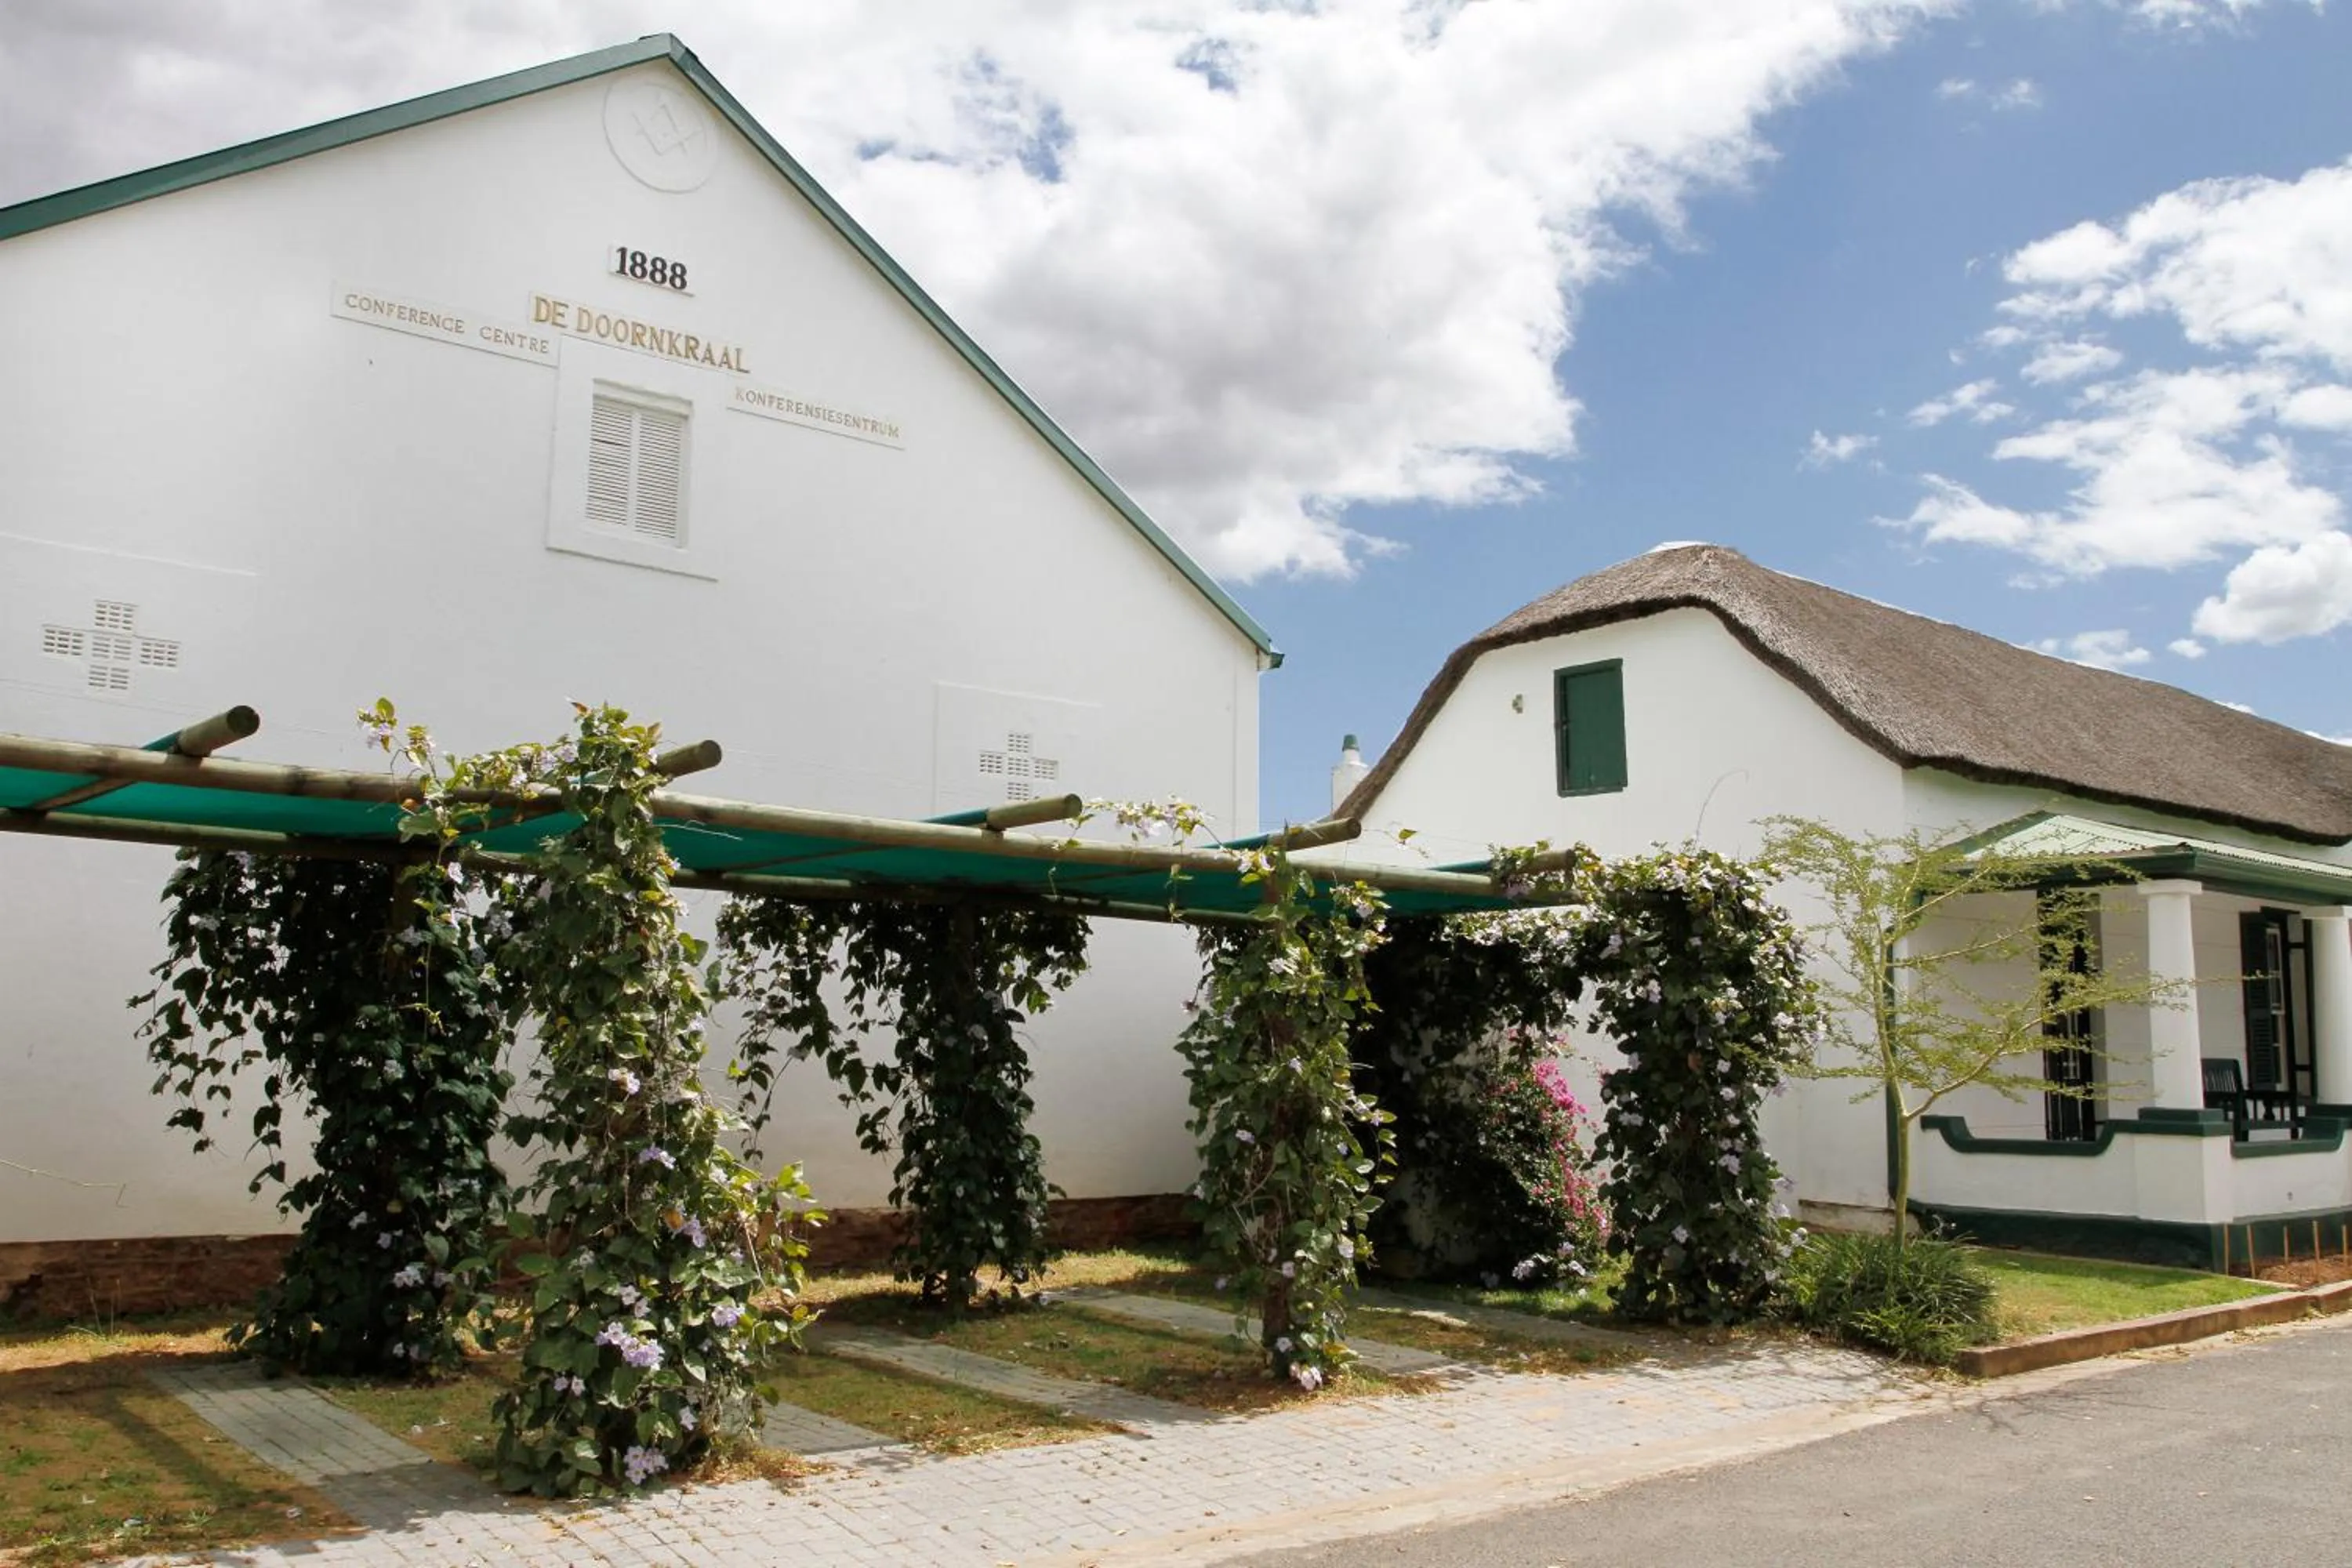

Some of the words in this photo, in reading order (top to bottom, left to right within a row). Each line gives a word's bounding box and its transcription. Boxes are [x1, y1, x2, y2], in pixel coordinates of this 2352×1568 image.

[615, 246, 688, 291] 1888
[345, 293, 465, 334] CONFERENCE
[479, 325, 550, 354] CENTRE
[533, 295, 569, 328] DE
[575, 307, 750, 374] DOORNKRAAL
[735, 386, 901, 439] KONFERENSIESENTRUM
